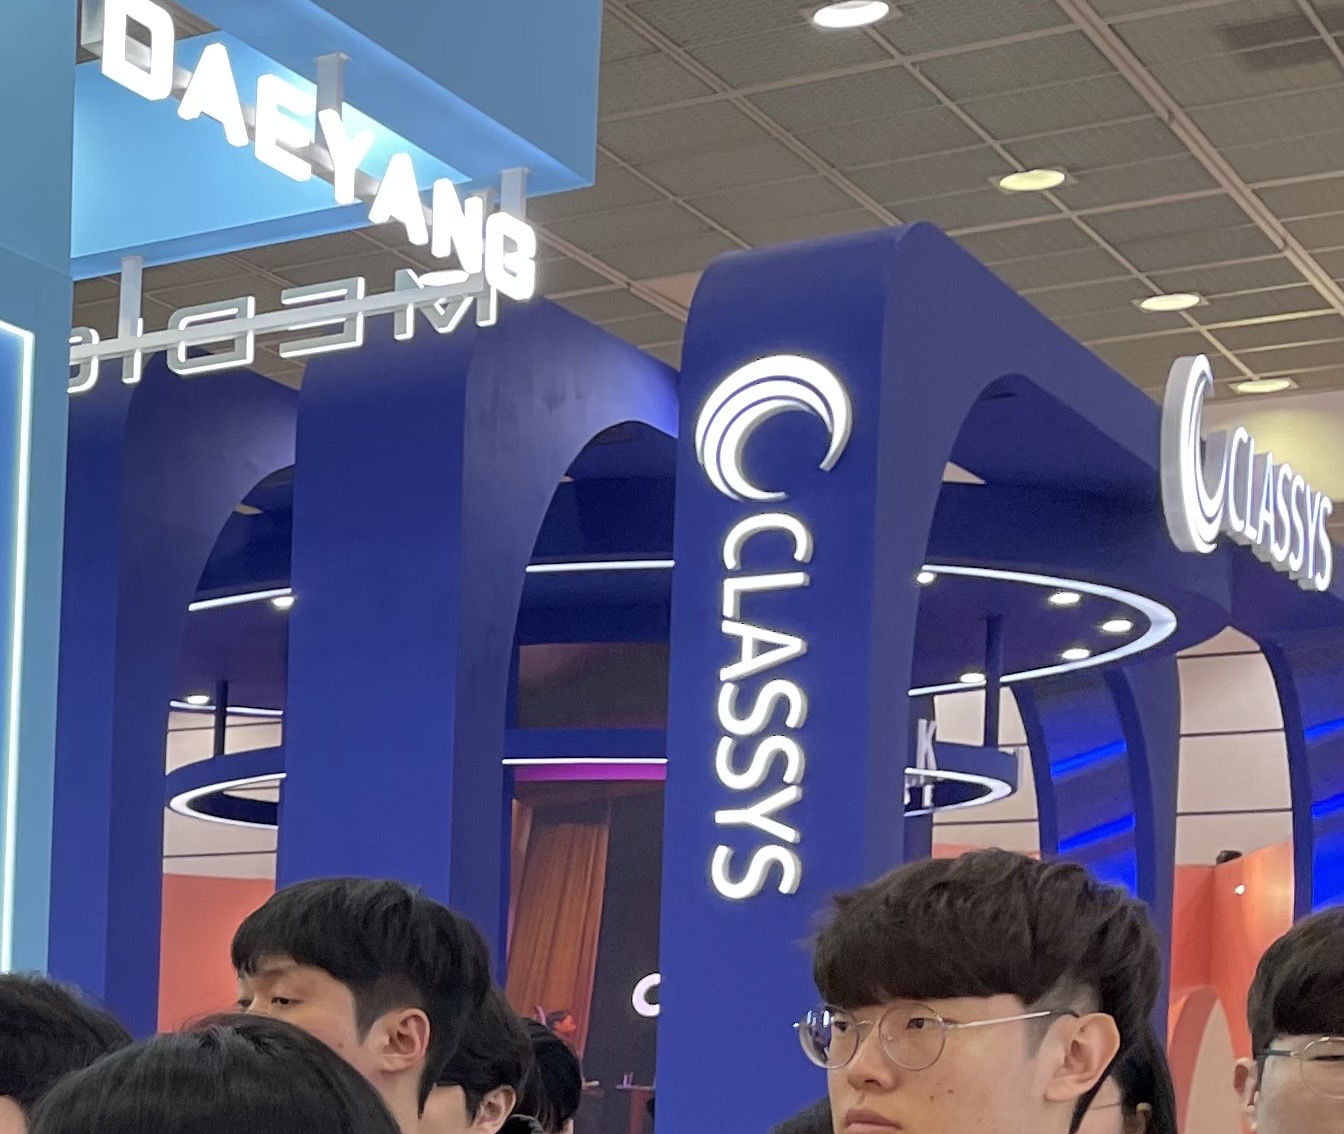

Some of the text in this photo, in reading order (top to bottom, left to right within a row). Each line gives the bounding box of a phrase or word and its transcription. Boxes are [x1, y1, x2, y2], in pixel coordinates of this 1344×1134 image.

[100, 0, 538, 301] DAEYANG
[1225, 424, 1335, 592] CLASSYS
[708, 511, 814, 901] CLASSYS
